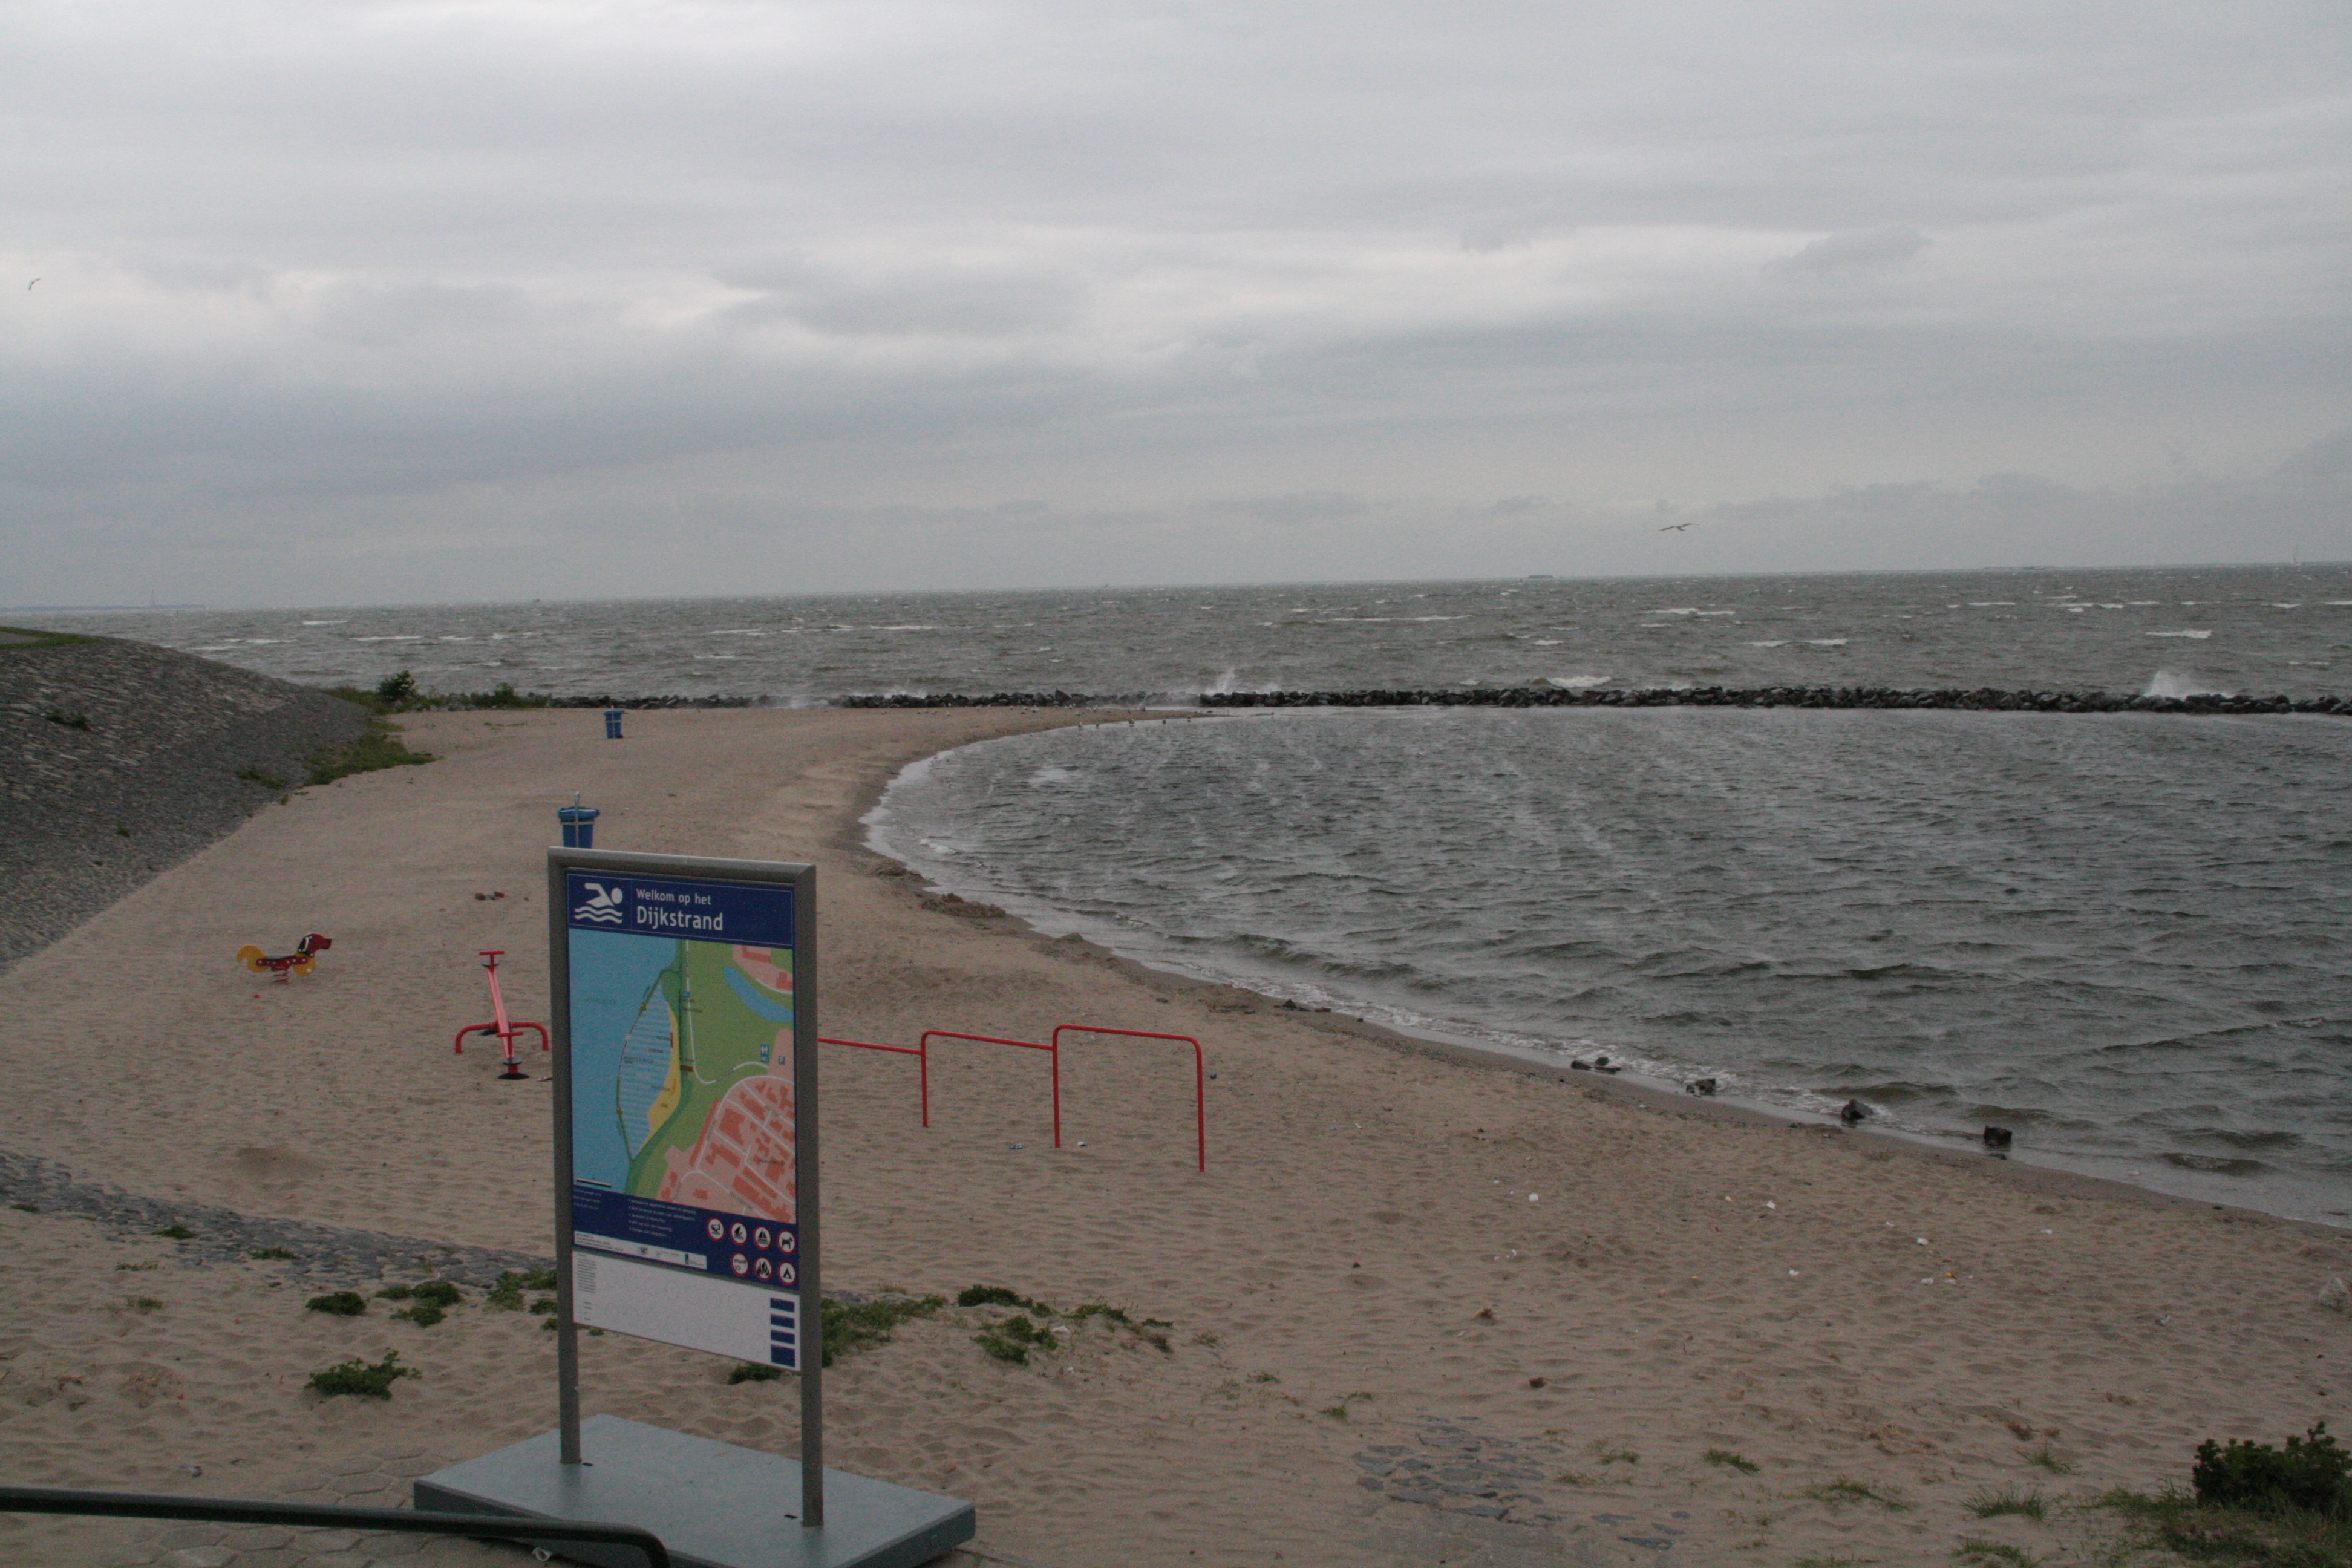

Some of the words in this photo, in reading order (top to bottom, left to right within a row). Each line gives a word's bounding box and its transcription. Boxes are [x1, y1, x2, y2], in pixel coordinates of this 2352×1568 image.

[636, 888, 675, 902] Welkom
[678, 894, 691, 906] op
[695, 893, 712, 905] het
[637, 905, 723, 931] Dijkstrand
